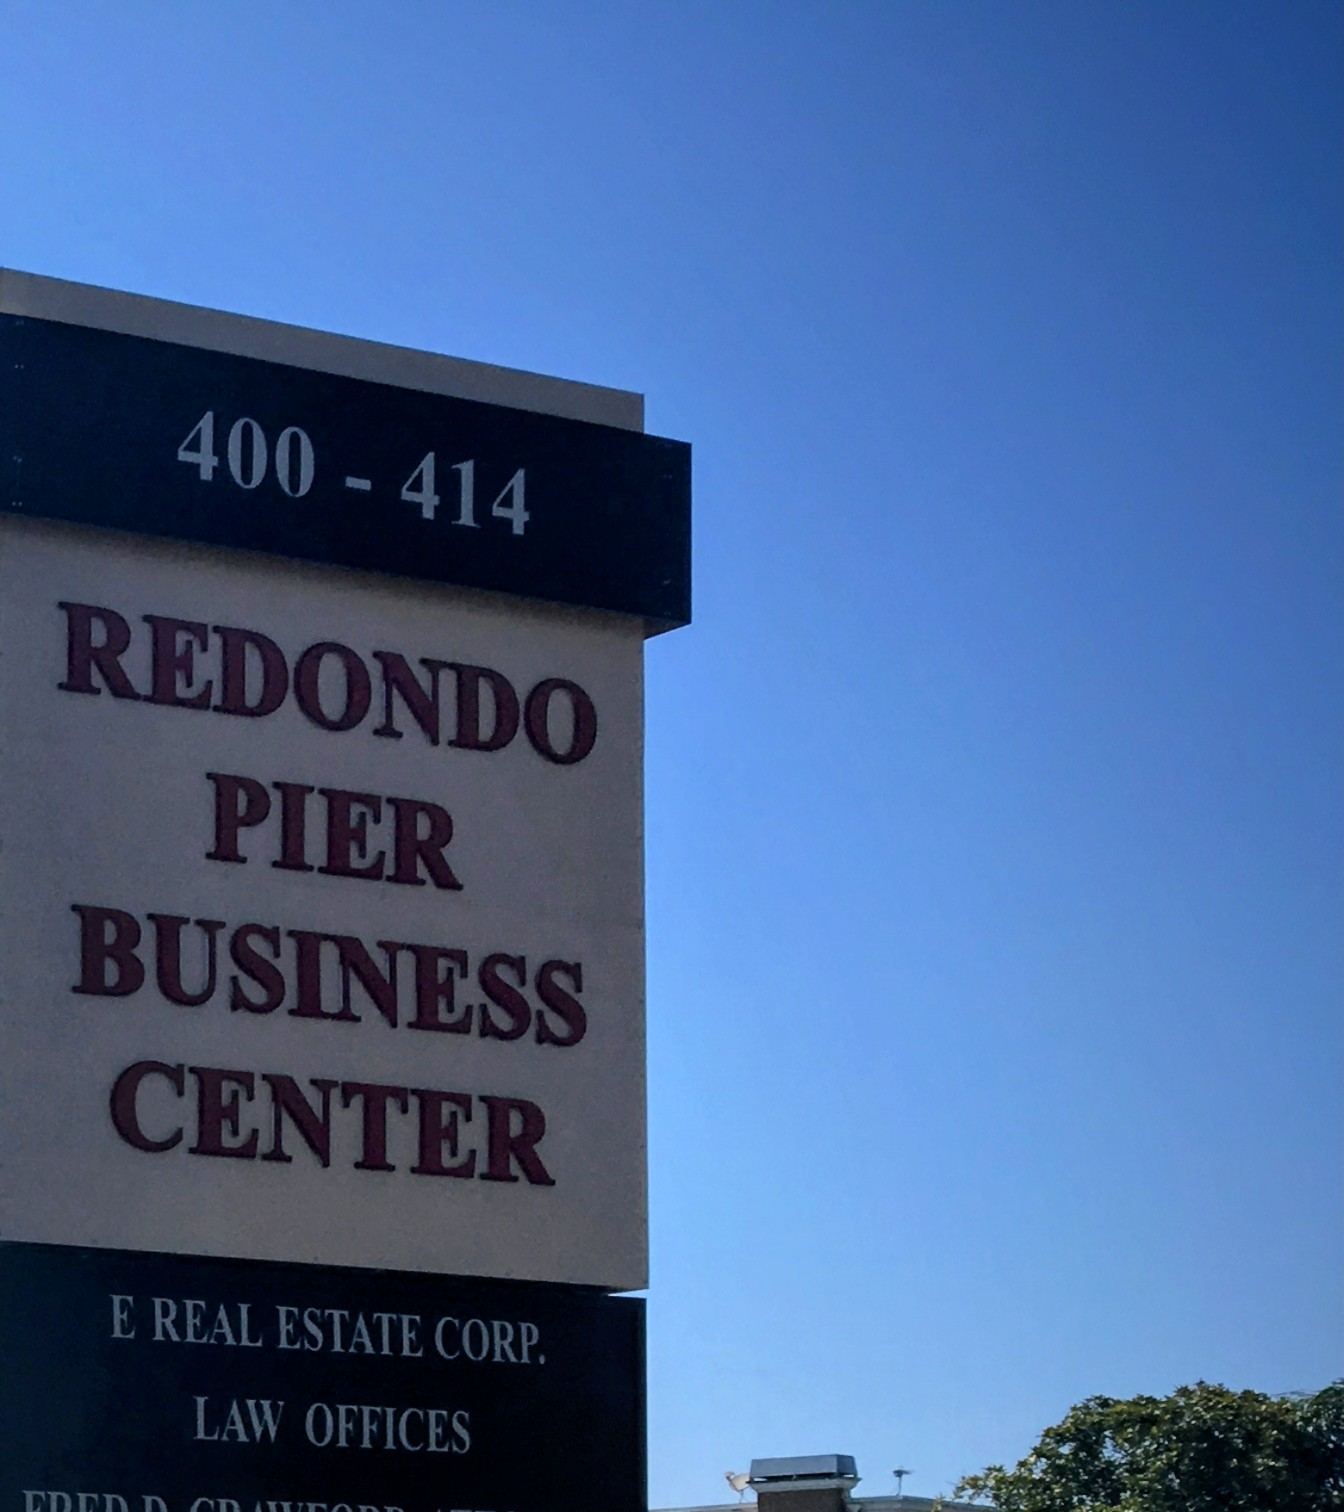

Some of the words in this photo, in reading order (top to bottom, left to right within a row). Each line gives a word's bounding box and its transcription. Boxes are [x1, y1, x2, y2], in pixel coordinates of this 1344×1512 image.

[177, 410, 313, 498] 400
[345, 474, 372, 491] -
[400, 451, 531, 536] 414
[57, 600, 599, 766] REDONDO
[205, 772, 463, 892] PIER
[70, 903, 588, 1048] BUSINESS
[108, 1060, 557, 1187] CENTER
[109, 1294, 135, 1339] E
[152, 1297, 263, 1347] REAL
[275, 1305, 424, 1358] ESTATE
[434, 1316, 547, 1365] CORP.
[195, 1396, 284, 1443] LAW
[305, 1402, 471, 1454] OFFICES
